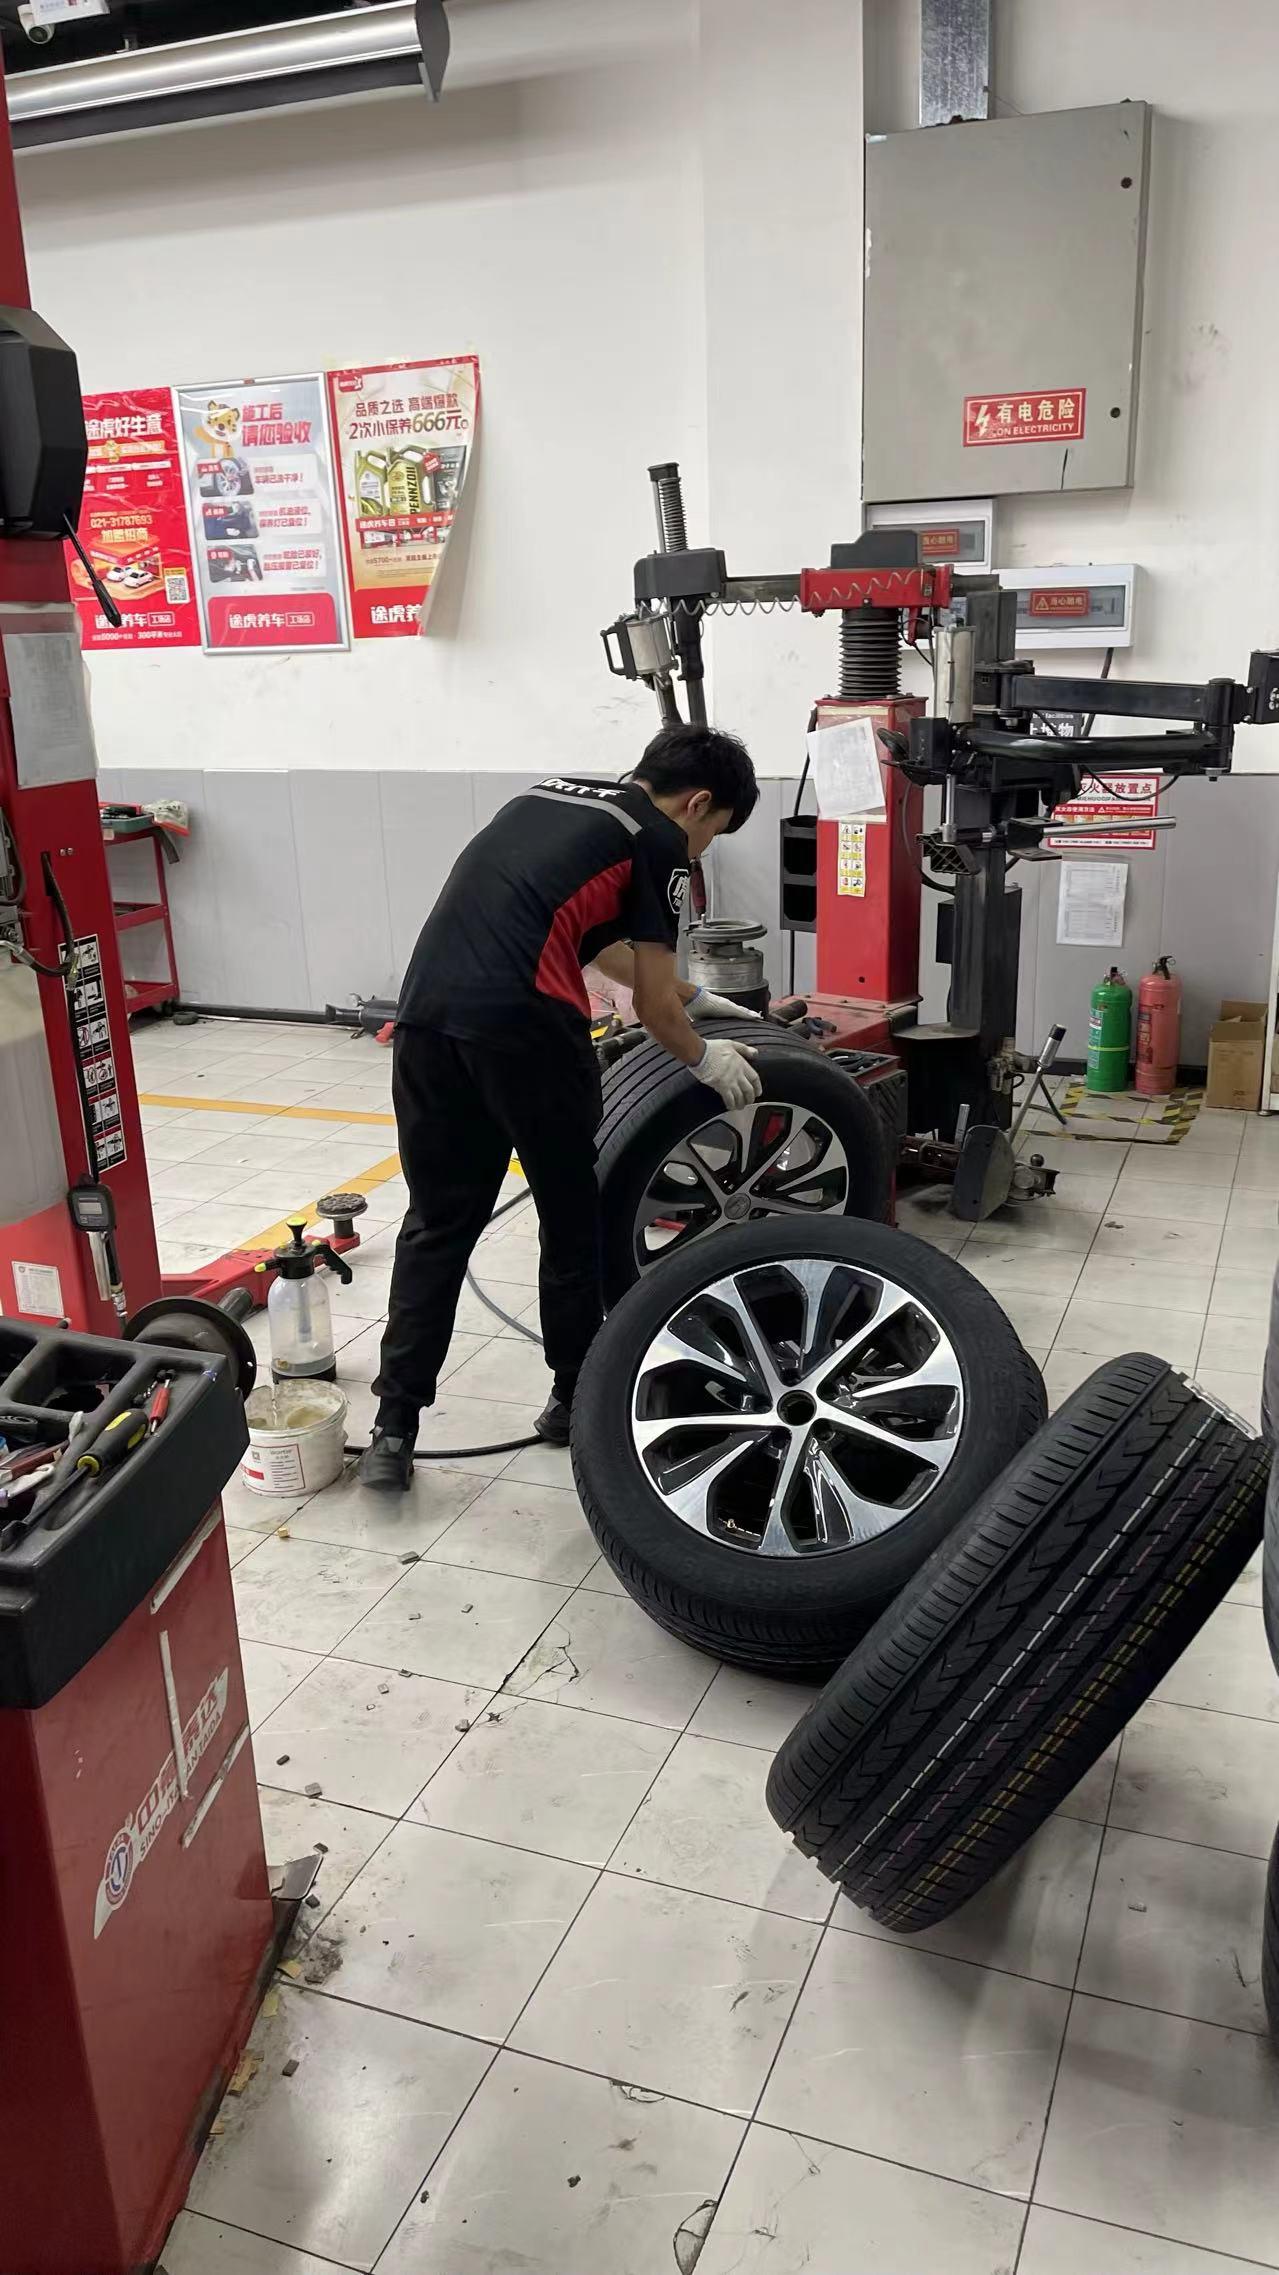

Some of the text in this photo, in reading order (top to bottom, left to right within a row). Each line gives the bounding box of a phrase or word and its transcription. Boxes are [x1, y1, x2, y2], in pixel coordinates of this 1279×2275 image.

[241, 403, 283, 422] 施工后
[355, 399, 405, 418] 品质之选
[996, 398, 1075, 424] 有电危险
[242, 421, 312, 447] 请您验收
[1013, 422, 1075, 435] ELECTRICITY
[229, 613, 286, 629] 途虎养车
